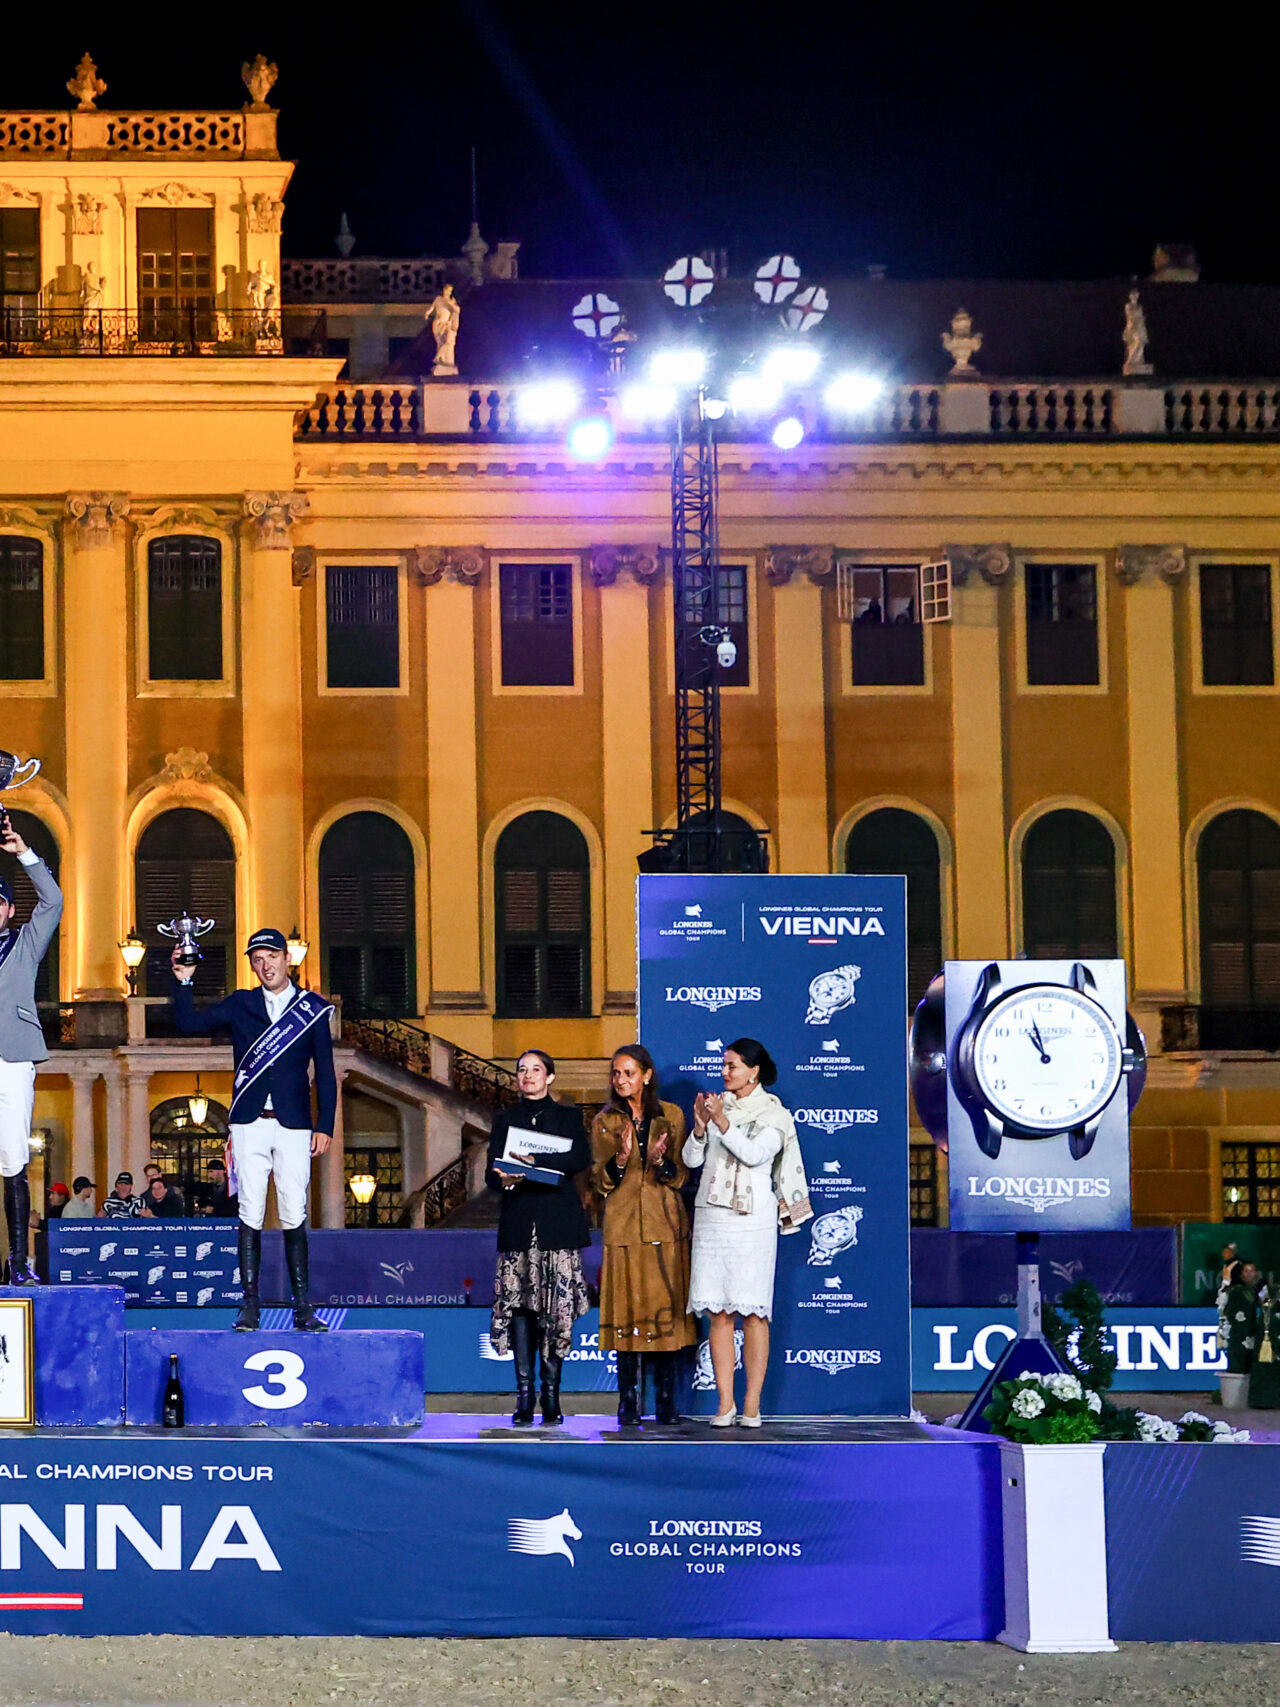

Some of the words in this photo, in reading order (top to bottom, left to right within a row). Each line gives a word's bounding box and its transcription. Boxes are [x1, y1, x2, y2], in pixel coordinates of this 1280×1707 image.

[759, 916, 885, 936] VIENNA
[665, 987, 762, 1002] LONGINES
[794, 1108, 878, 1124] ONGINES
[968, 1176, 1111, 1198] LONGINES
[329, 1294, 380, 1305] GLOBAL
[385, 1294, 466, 1305] CHAMPIONS
[785, 1350, 882, 1364] LONGINES
[242, 1349, 308, 1410] 3
[35, 1463, 194, 1481] CHAMPIONS
[201, 1465, 274, 1481] TOUR
[648, 1520, 762, 1537] LONGINES
[609, 1542, 682, 1558] GLOBAL
[688, 1542, 802, 1557] CHAMPIONS
[686, 1563, 726, 1574] TOUR
